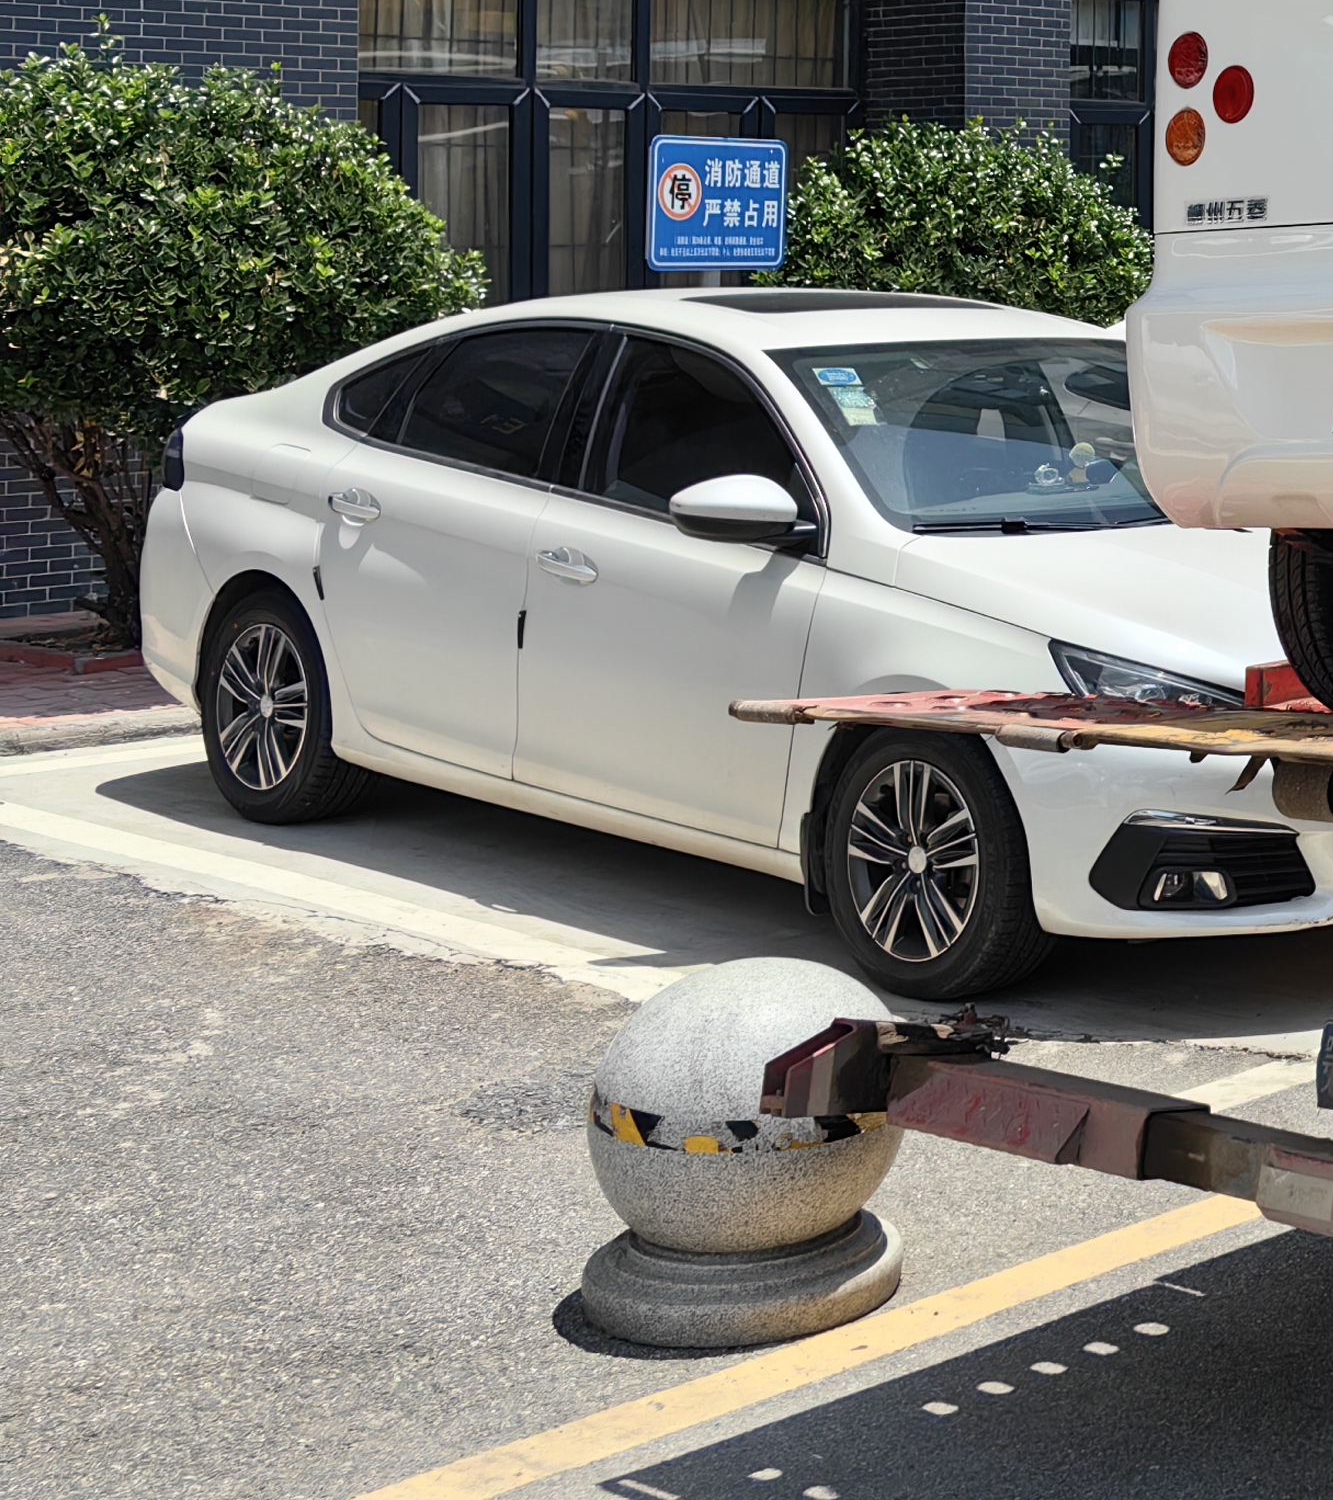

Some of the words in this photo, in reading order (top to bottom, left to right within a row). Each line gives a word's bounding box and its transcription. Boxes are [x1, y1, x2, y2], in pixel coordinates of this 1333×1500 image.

[704, 158, 781, 189] 消防通道
[668, 173, 693, 211] 停
[702, 198, 779, 228] 严禁占用
